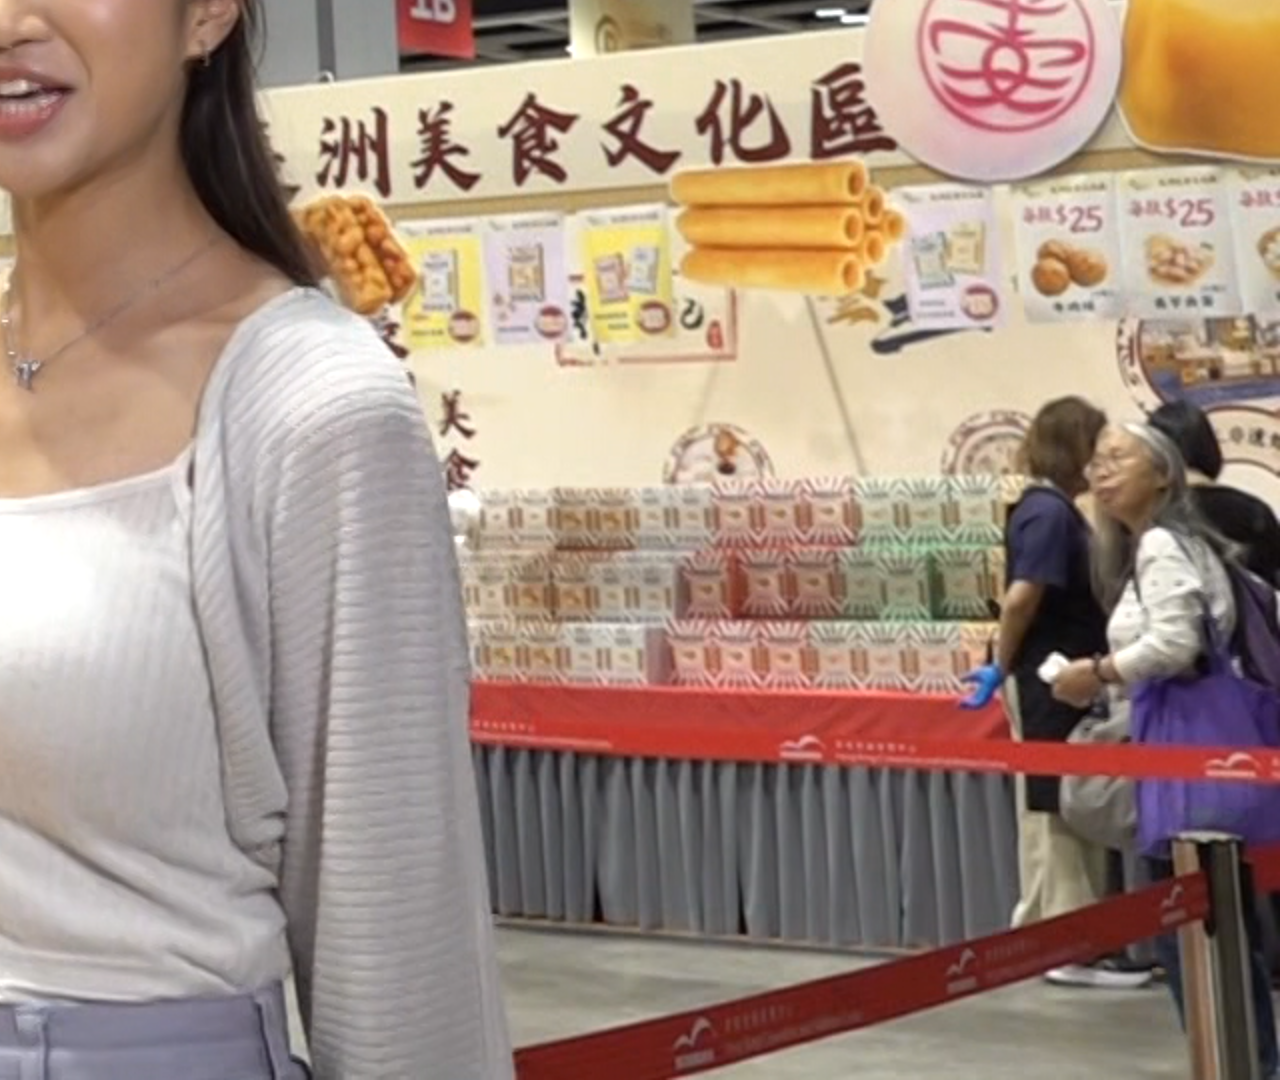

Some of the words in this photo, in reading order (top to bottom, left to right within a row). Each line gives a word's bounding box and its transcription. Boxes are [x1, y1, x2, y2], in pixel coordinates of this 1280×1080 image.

[272, 62, 899, 198] 洲美食文化區
